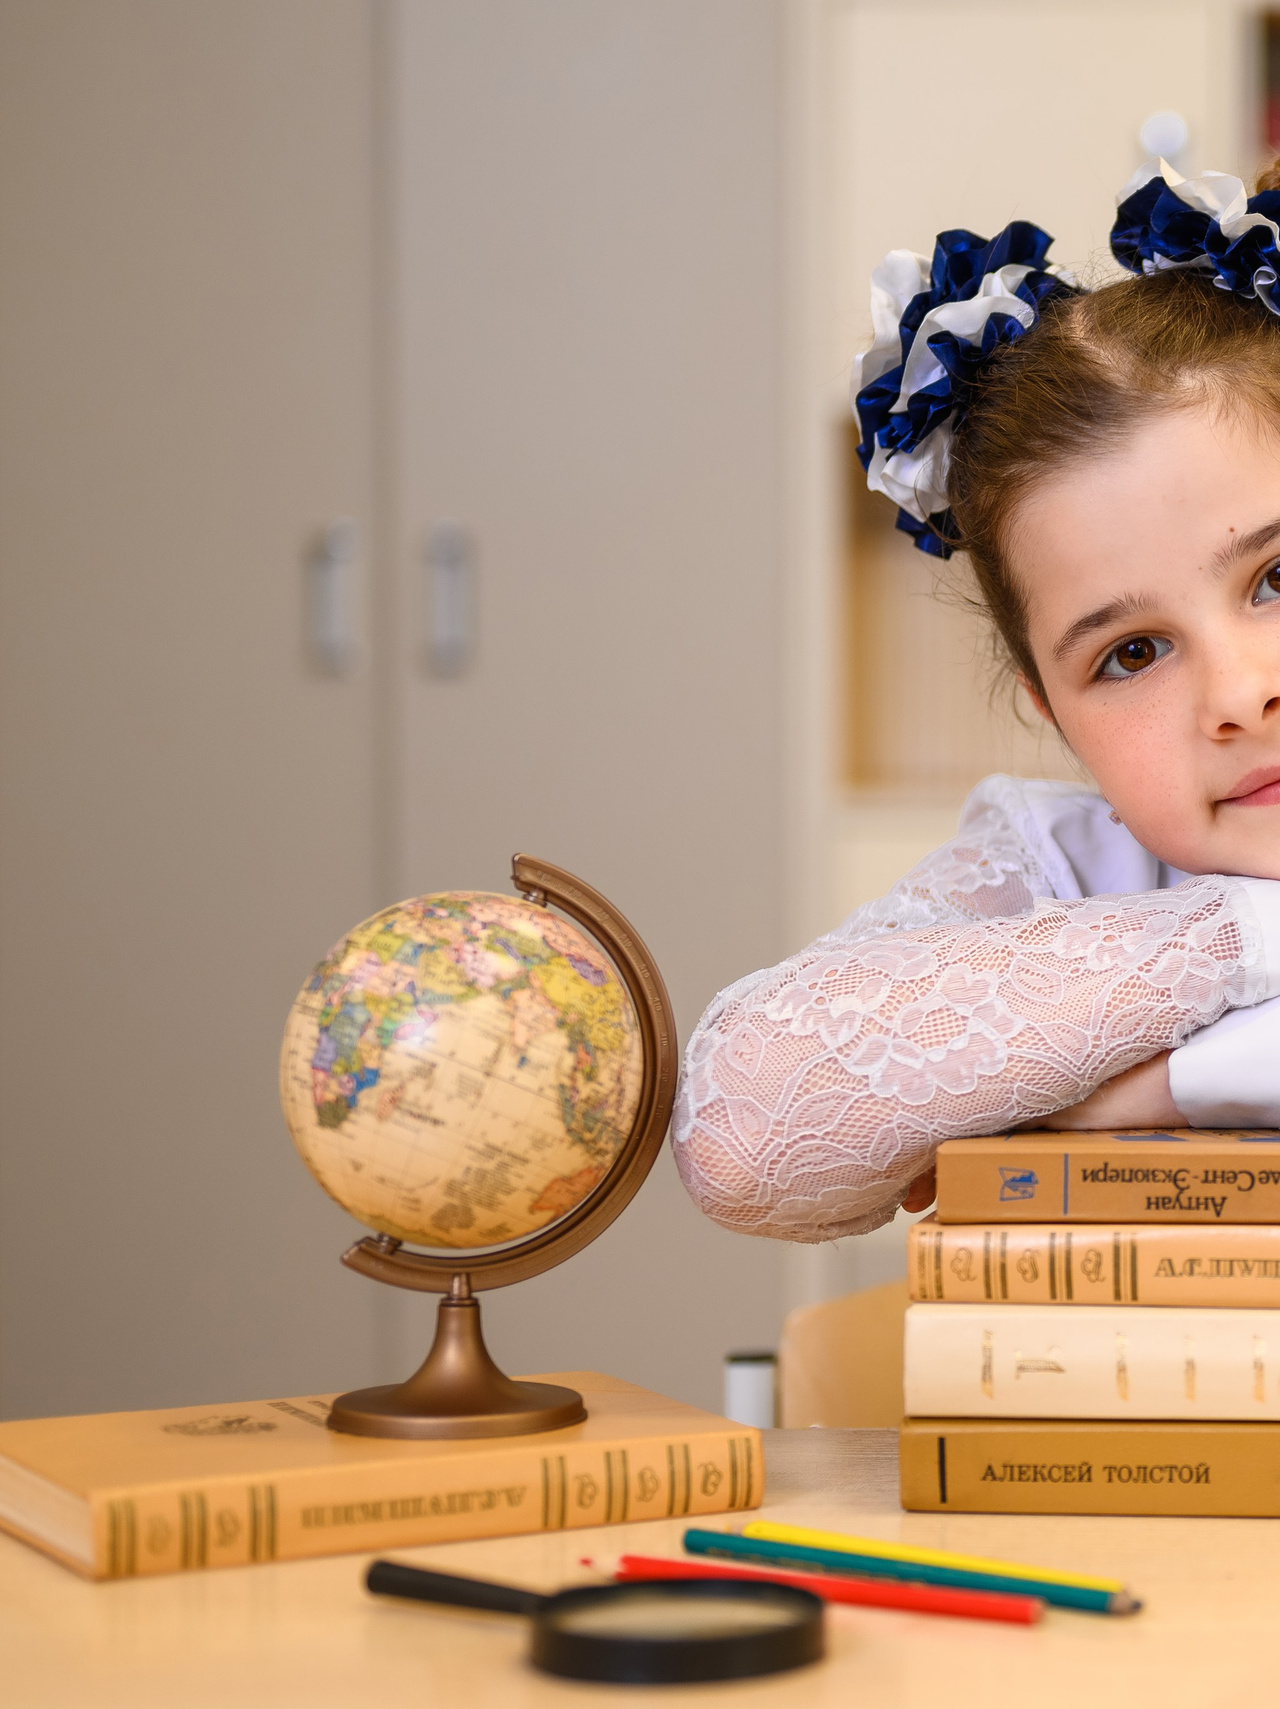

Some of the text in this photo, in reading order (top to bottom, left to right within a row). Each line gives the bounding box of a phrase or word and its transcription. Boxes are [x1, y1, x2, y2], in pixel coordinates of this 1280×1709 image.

[1144, 1190, 1228, 1218] Антуан
[980, 1462, 1211, 1485] АЛЕКСЕЙ ТОЛСТОЙ
